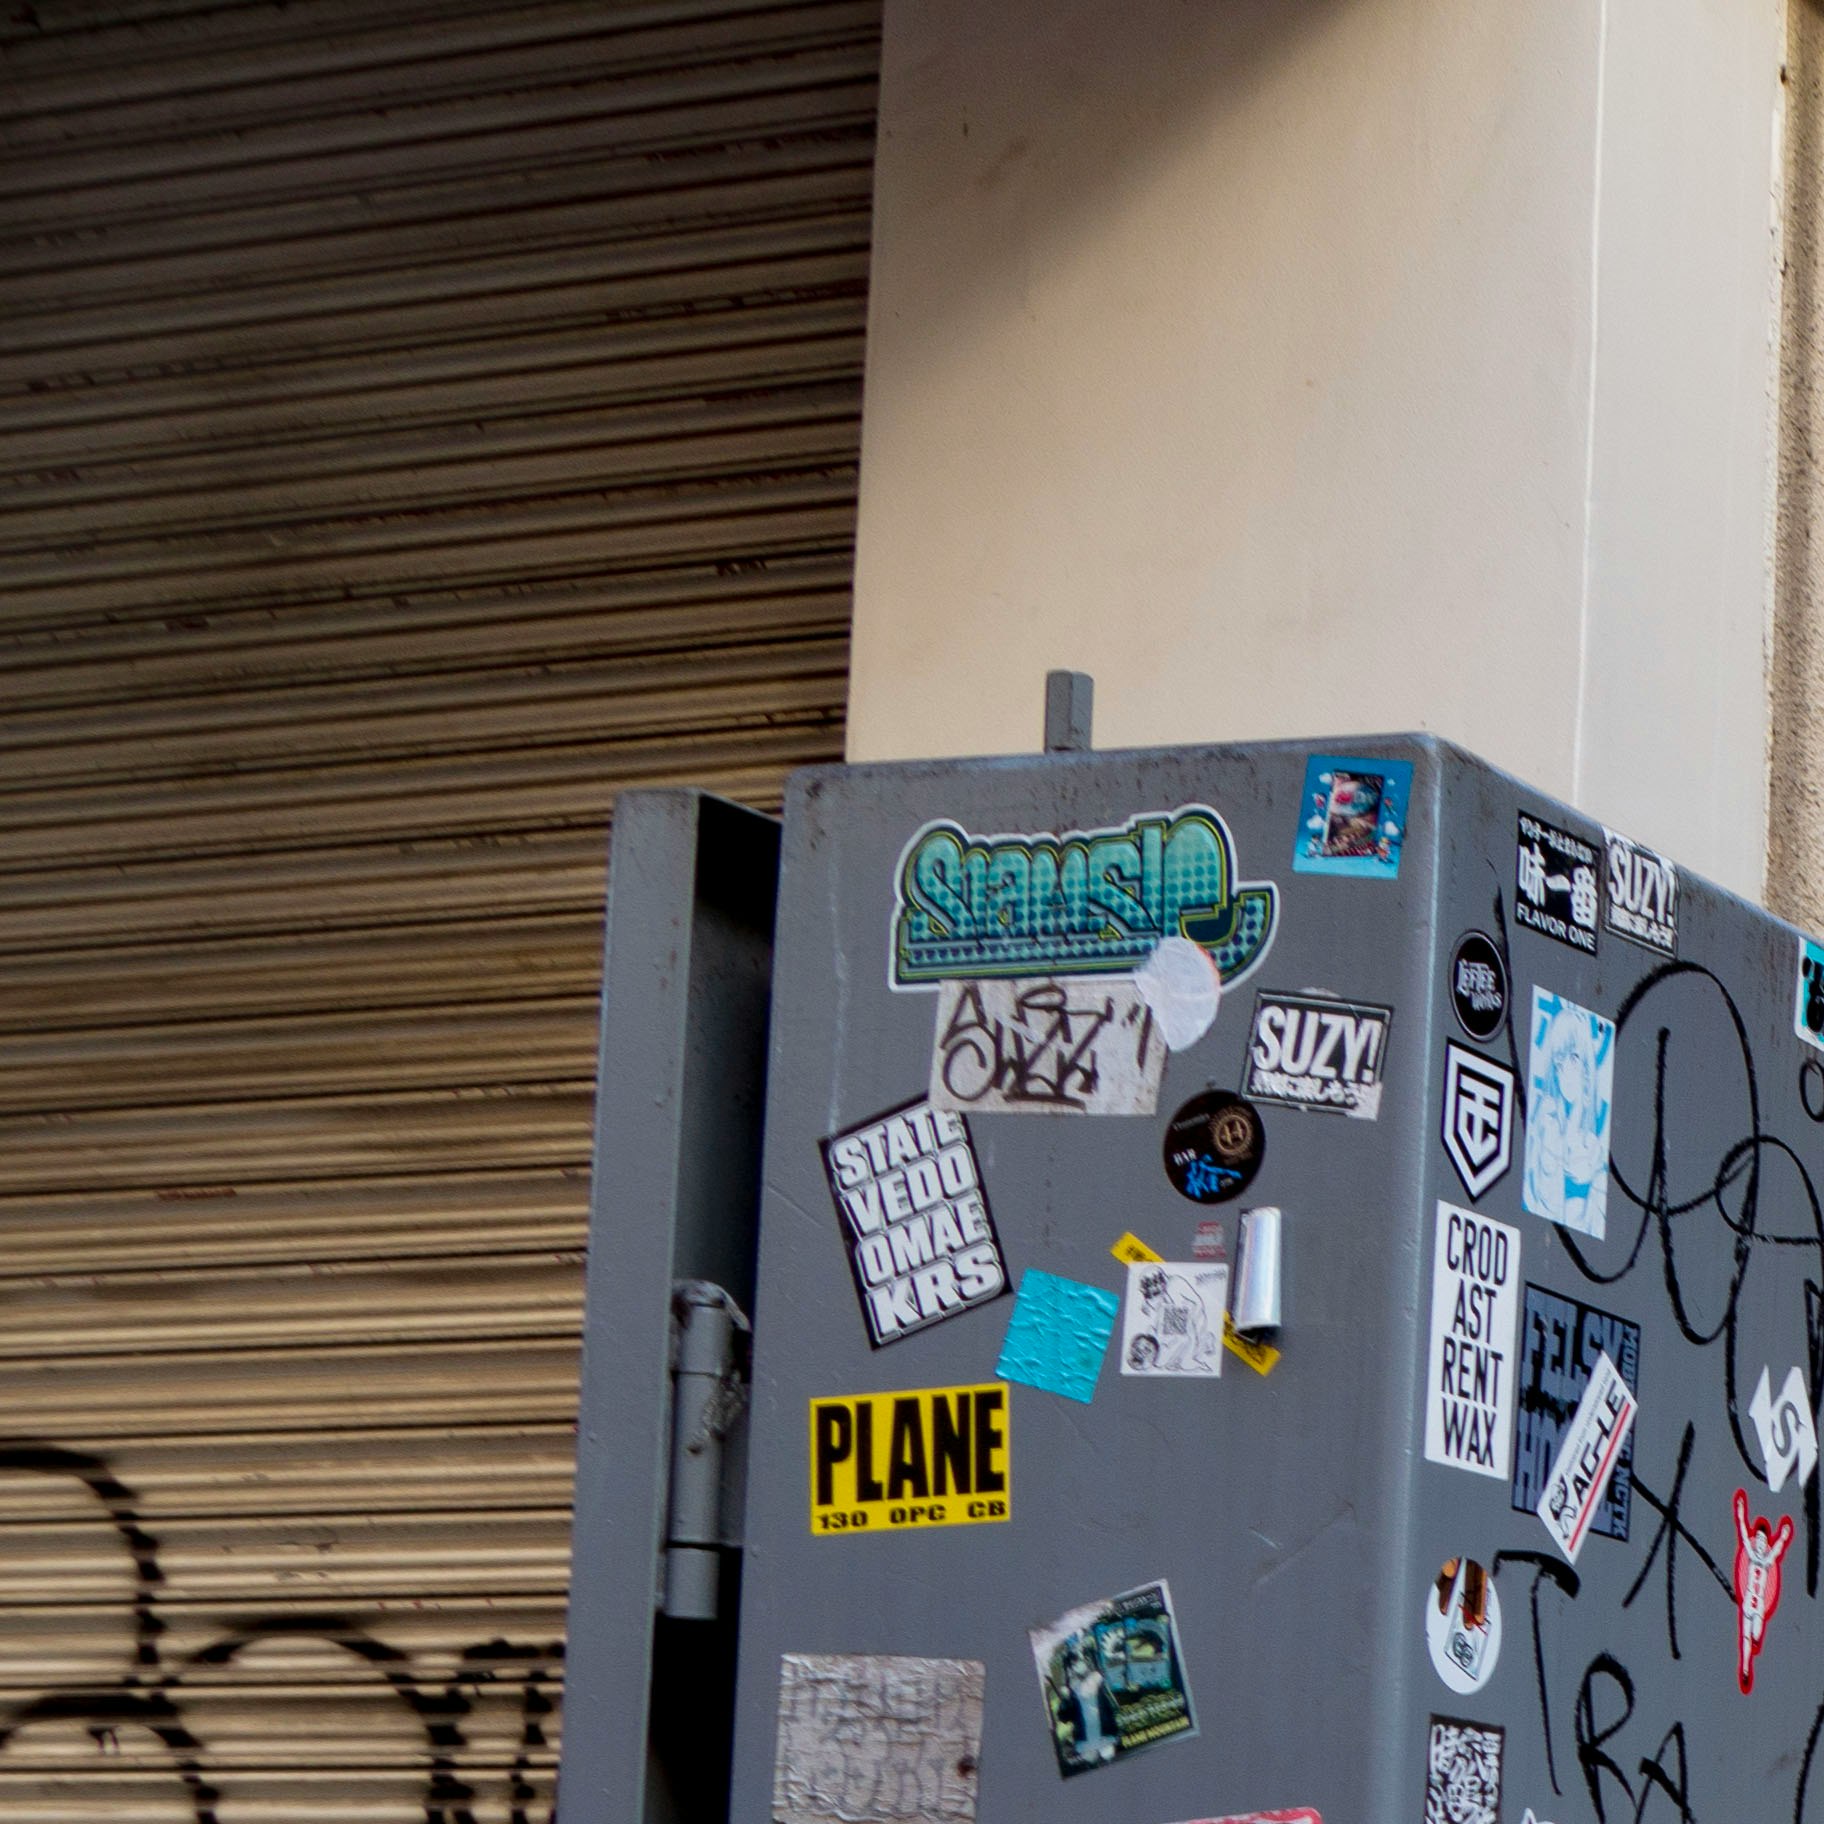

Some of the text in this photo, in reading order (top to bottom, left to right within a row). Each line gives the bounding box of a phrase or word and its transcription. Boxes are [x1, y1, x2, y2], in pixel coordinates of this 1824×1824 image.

[1608, 844, 1675, 928] SUZY!
[1517, 902, 1567, 938] FLAVOR
[1568, 926, 1596, 952] ONE
[1253, 1005, 1382, 1082] SUZY!
[830, 1105, 966, 1188] STATE
[839, 1140, 977, 1235] VEDO
[855, 1193, 989, 1285] OMAE
[1446, 1213, 1509, 1287] CROD
[867, 1242, 1005, 1345] KRS
[1452, 1279, 1499, 1342] AST
[1442, 1337, 1503, 1409] RENT
[816, 1389, 1007, 1507] PLANE
[1441, 1396, 1498, 1469] WAX
[818, 1498, 1008, 1530] 130 OPC CB
